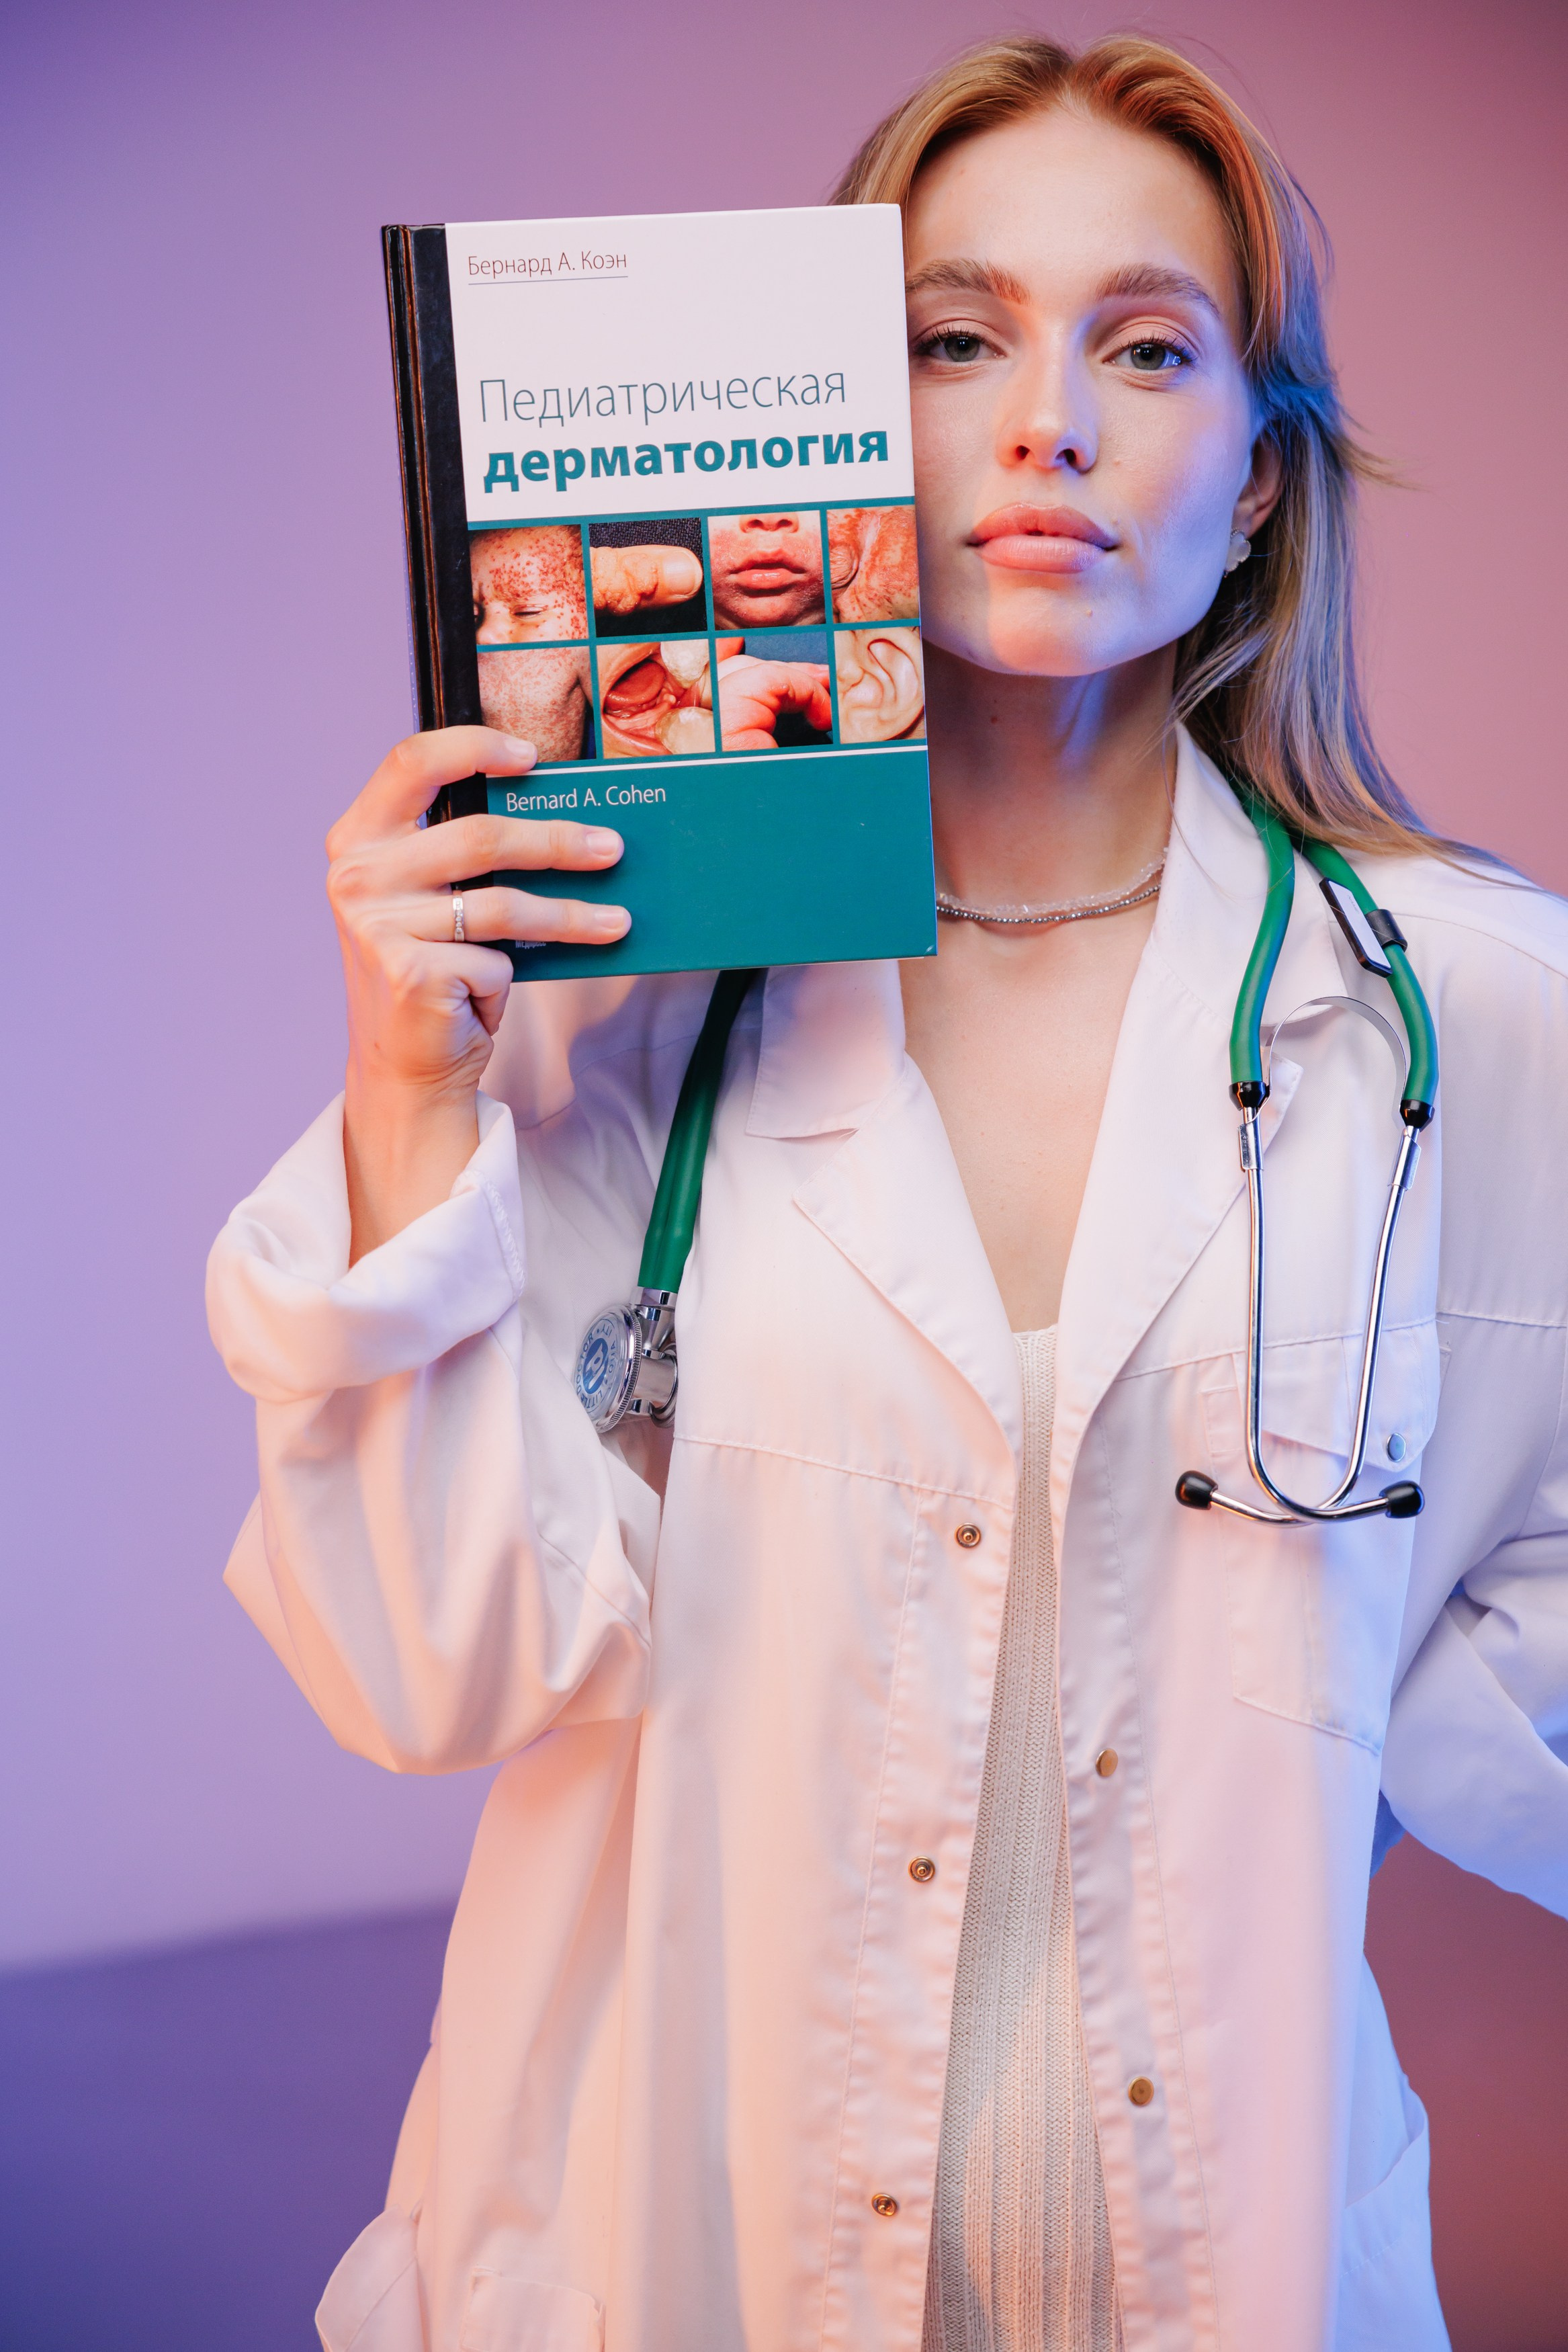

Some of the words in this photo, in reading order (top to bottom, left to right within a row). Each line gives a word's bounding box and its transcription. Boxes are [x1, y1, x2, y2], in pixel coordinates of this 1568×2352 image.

[468, 255, 552, 278] Бернард
[581, 250, 627, 270] Коэн
[480, 372, 845, 429] Педиатрическая
[483, 430, 889, 494] дерматология
[507, 788, 578, 812] Bernard
[584, 788, 601, 806] A.
[606, 784, 666, 805] Cohen
[601, 1323, 615, 1374] QUAITY
